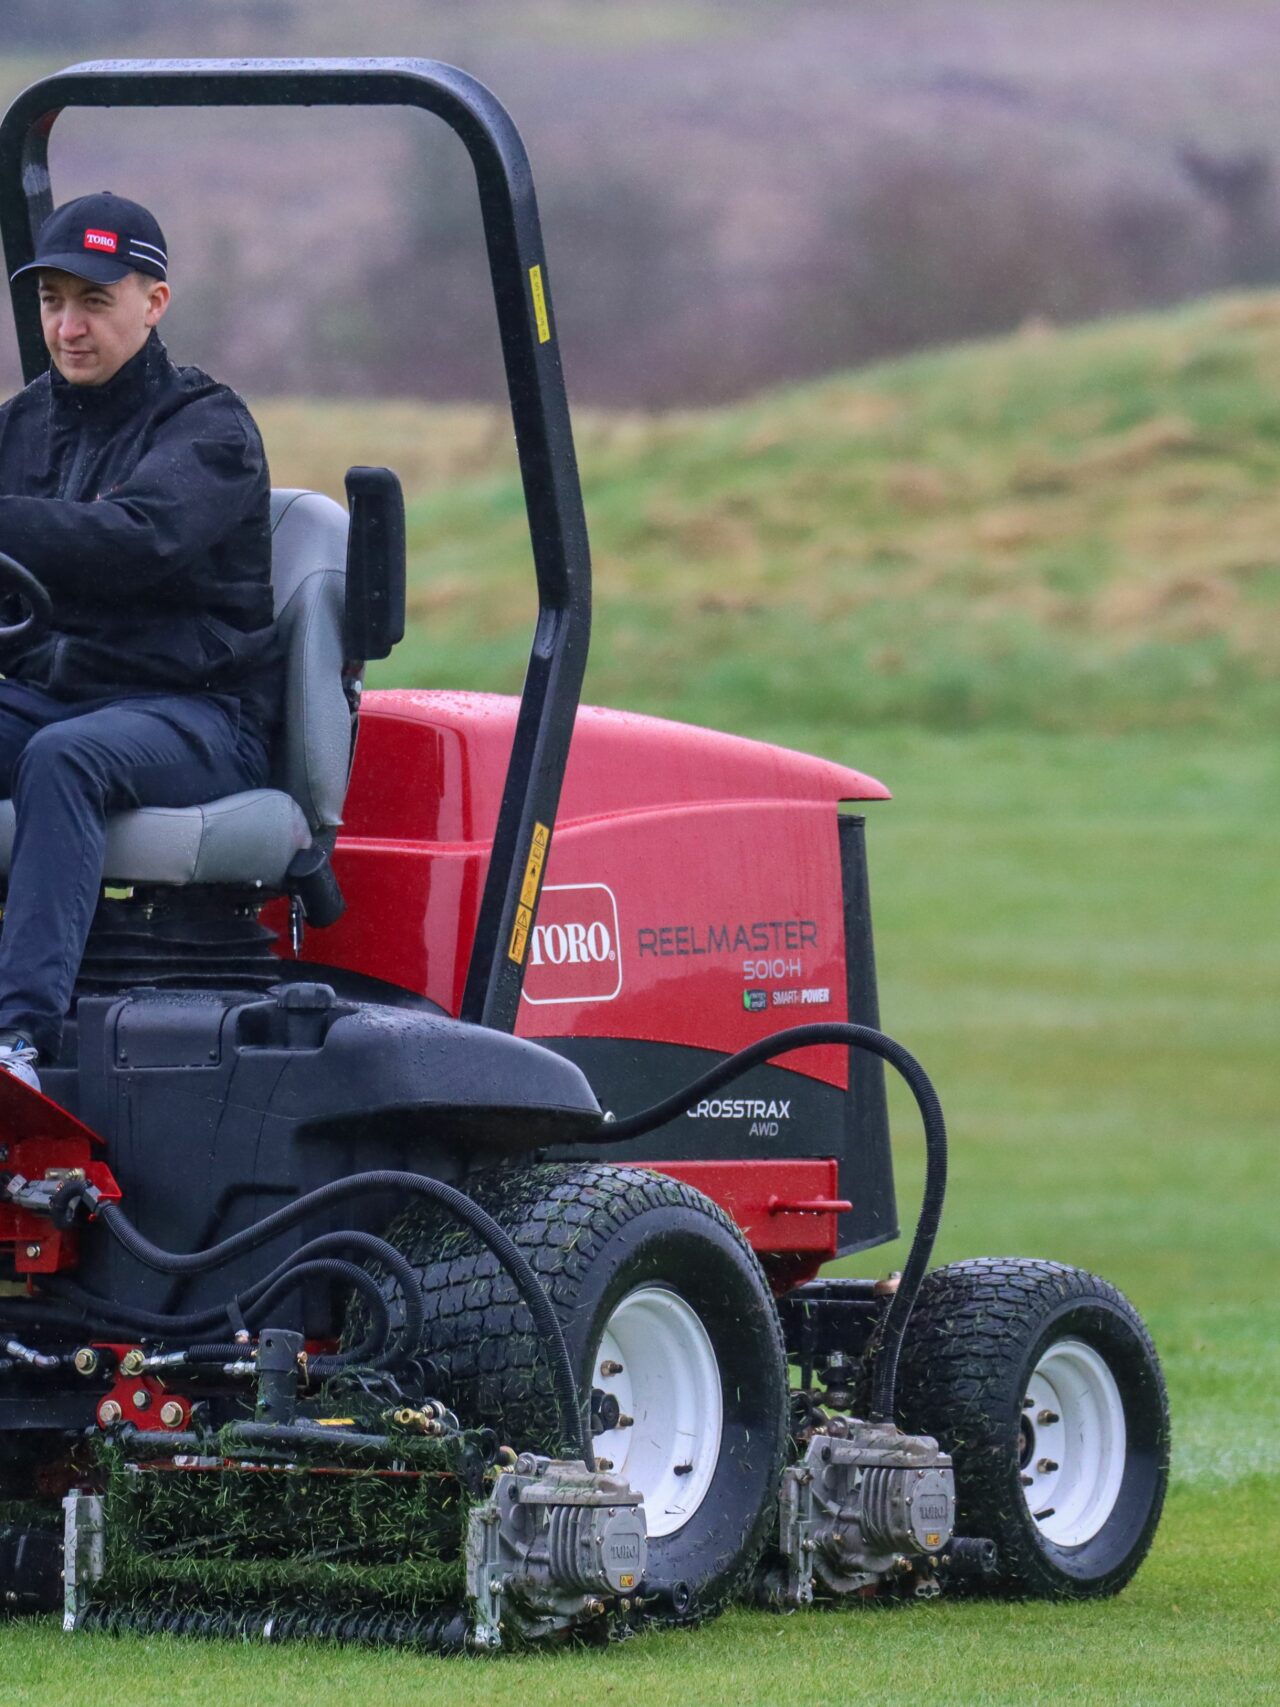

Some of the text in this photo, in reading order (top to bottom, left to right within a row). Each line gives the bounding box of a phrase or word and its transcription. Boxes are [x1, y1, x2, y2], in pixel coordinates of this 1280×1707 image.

[87, 234, 114, 248] TORO
[530, 921, 611, 965] TORO
[638, 920, 817, 956] REELMASTER
[772, 988, 830, 1005] SMART POWER
[749, 1122, 779, 1136] AWD
